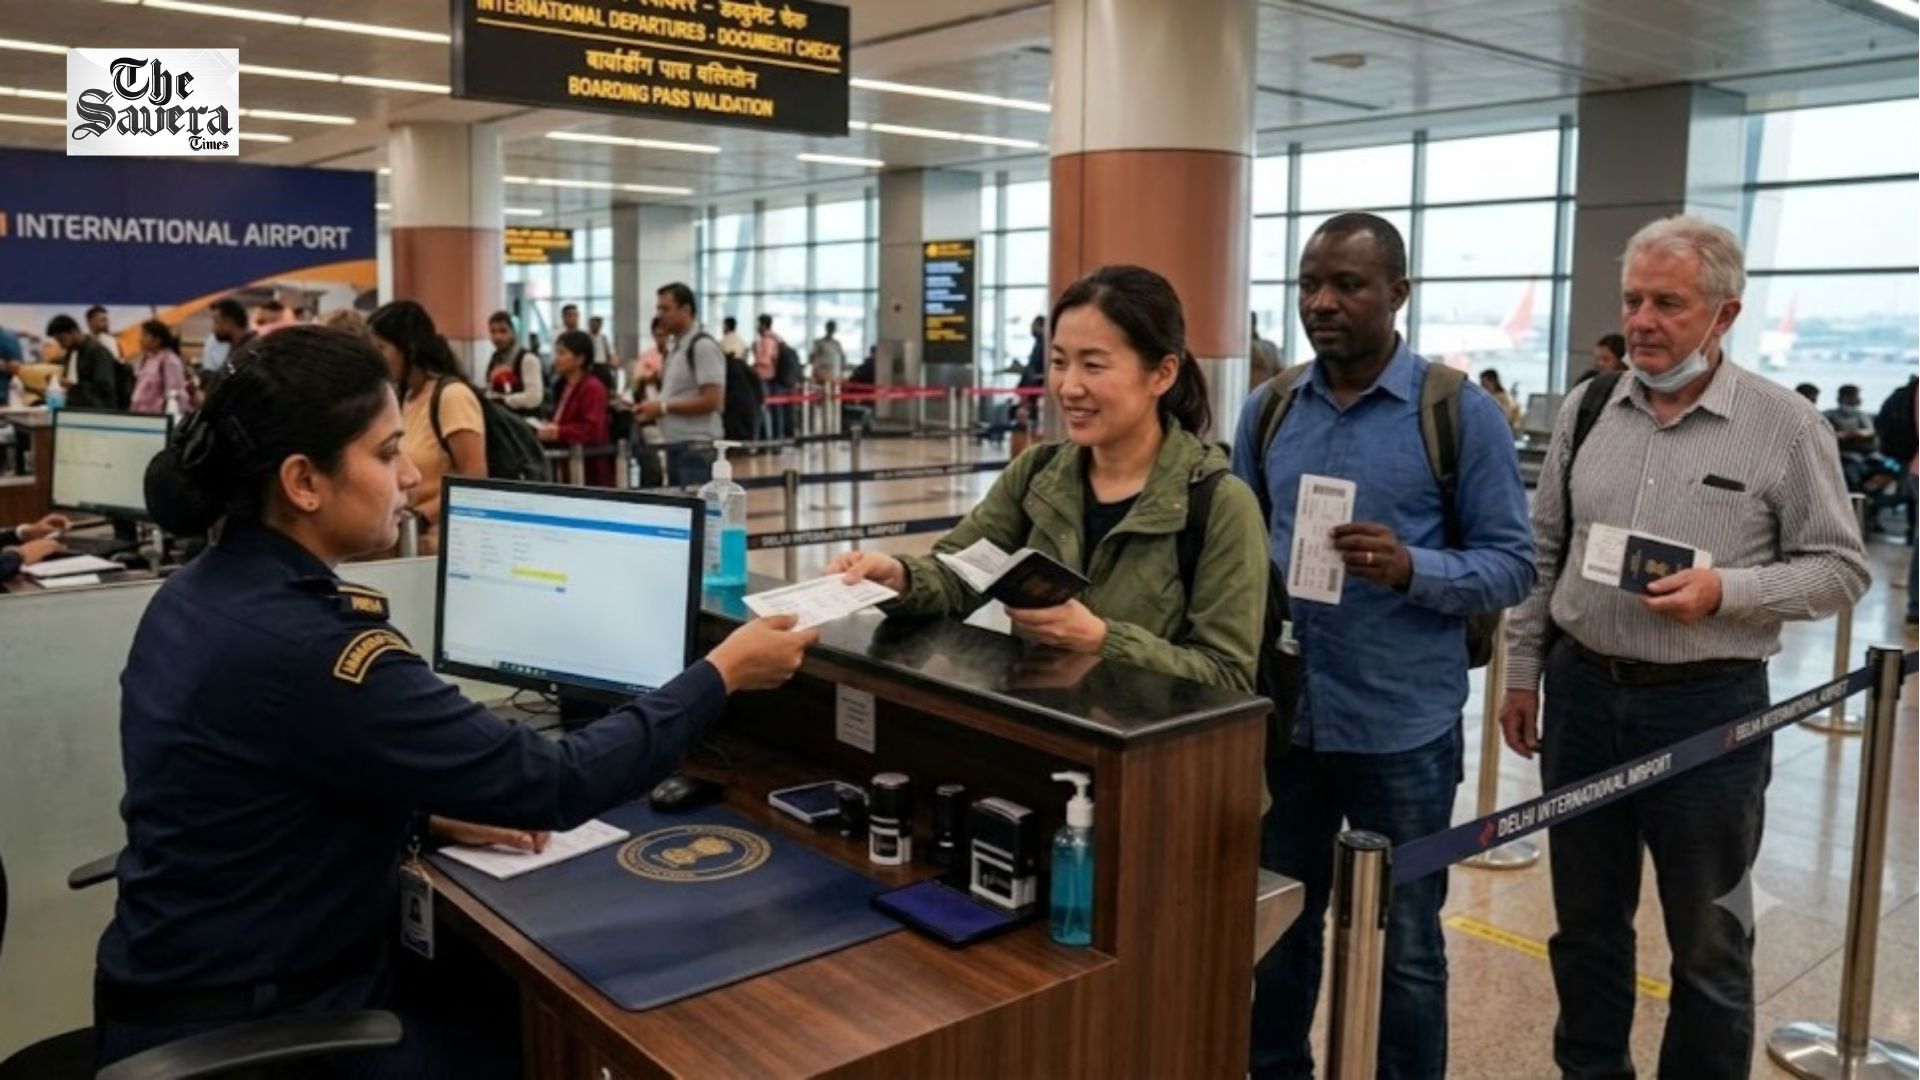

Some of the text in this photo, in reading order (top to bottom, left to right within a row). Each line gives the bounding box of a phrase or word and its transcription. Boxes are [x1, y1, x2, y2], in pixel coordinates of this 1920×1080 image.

[477, 0, 606, 28] INTERNATIONAL
[609, 10, 706, 40] DEPARTURES
[717, 27, 794, 55] DOCUMENT
[795, 40, 841, 62] CHECK
[568, 75, 774, 117] BOARDING PASS VALIDATION
[16, 213, 238, 247] INTERNATIONAL
[243, 223, 351, 249] AIRPORT
[1498, 752, 1673, 838] DELHI INTERNATIONAL AIRPORT
